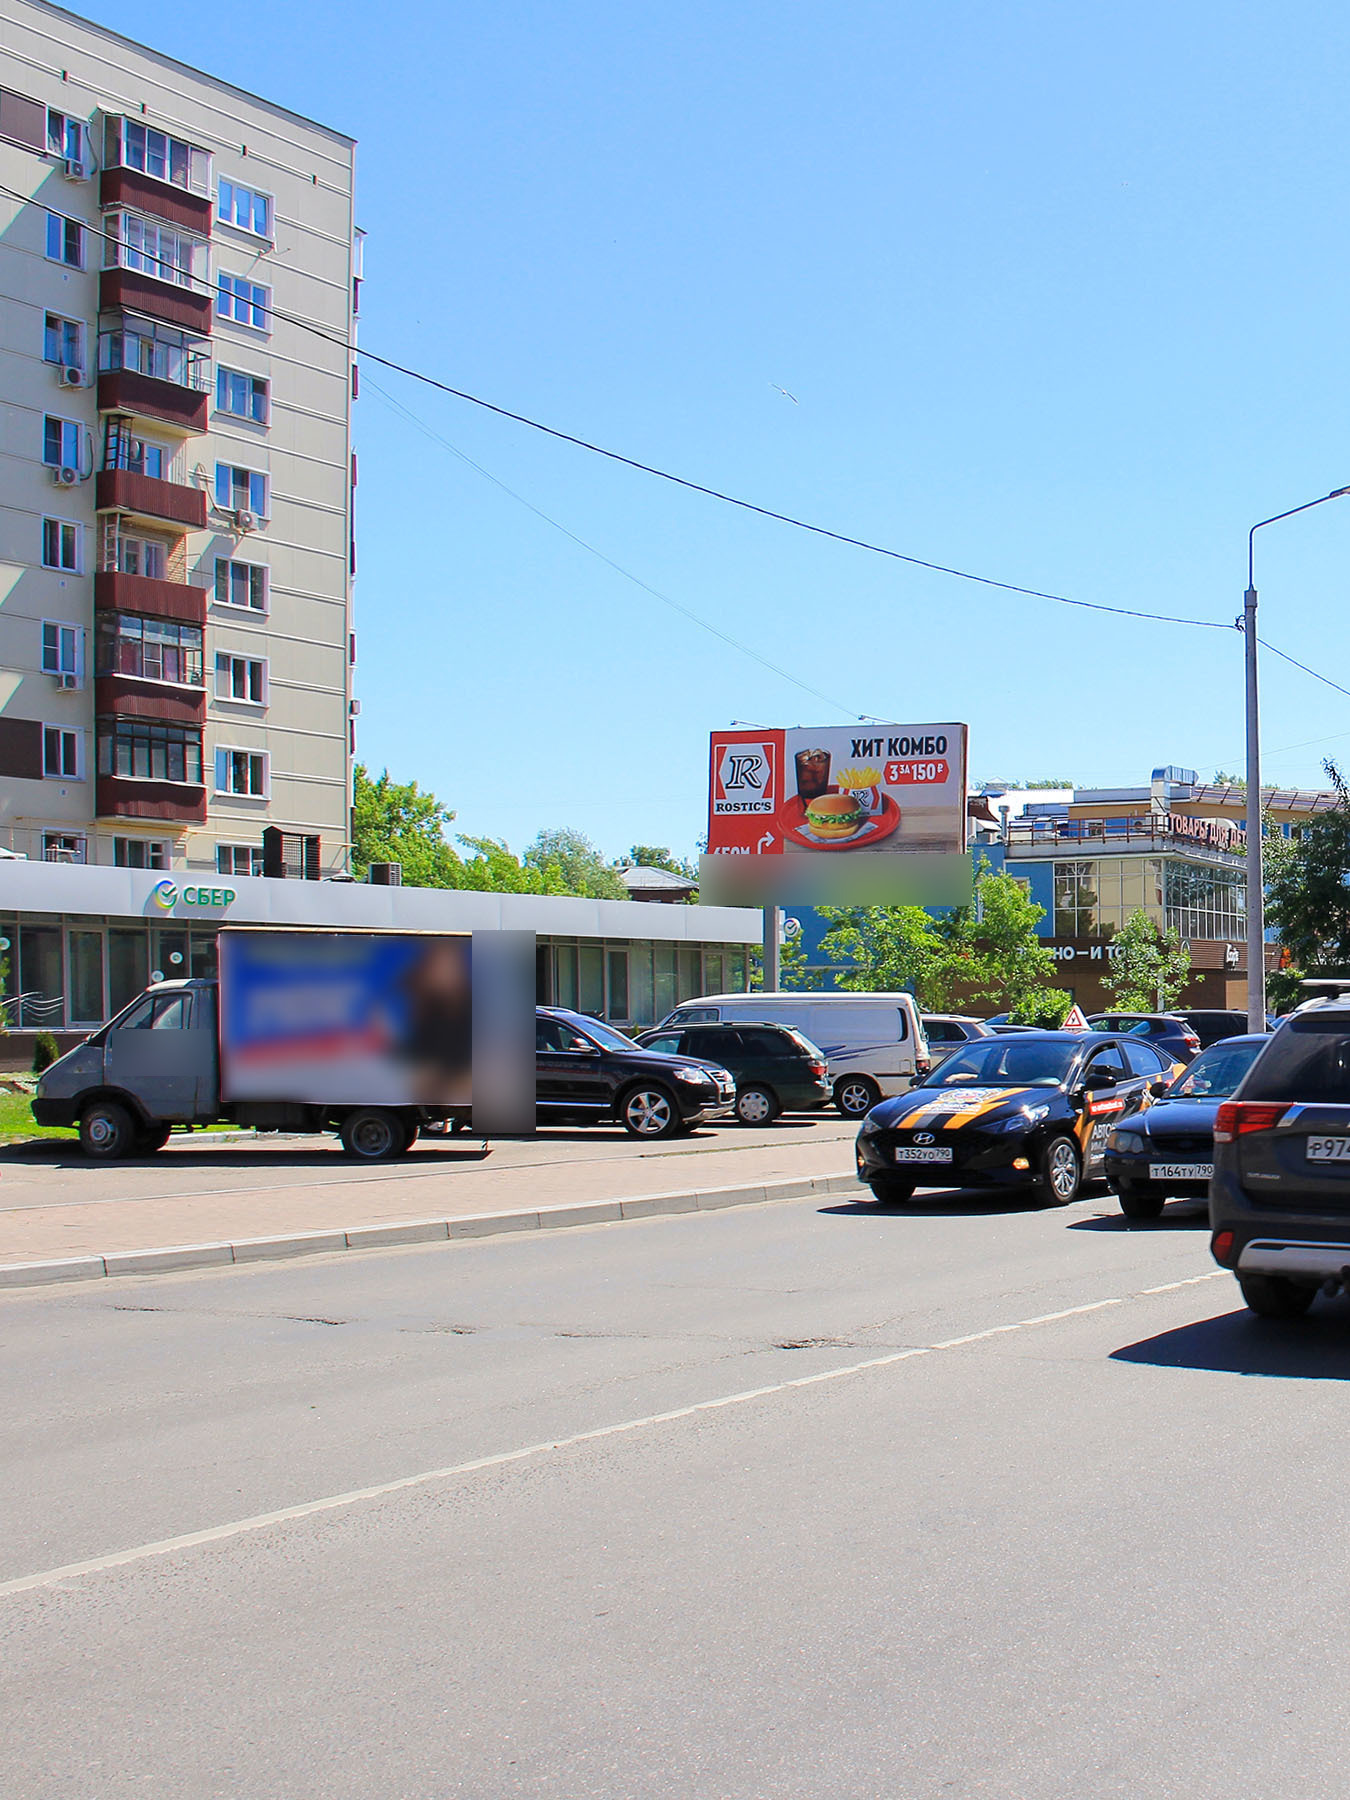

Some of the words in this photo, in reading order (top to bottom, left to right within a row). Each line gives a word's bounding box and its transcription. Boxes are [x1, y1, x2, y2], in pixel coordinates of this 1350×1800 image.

[851, 738, 884, 758] ХИТ
[887, 736, 947, 756] КОМБО
[725, 755, 763, 789] R
[716, 802, 772, 812] ROSTIC'S
[1168, 812, 1209, 840] ТОВАРЫ
[183, 886, 236, 906] СБЕР
[898, 1149, 934, 1160] Т352УО
[935, 1148, 950, 1157] 790
[1152, 1166, 1194, 1177] Т164ТУ
[1196, 1165, 1213, 1174] 790
